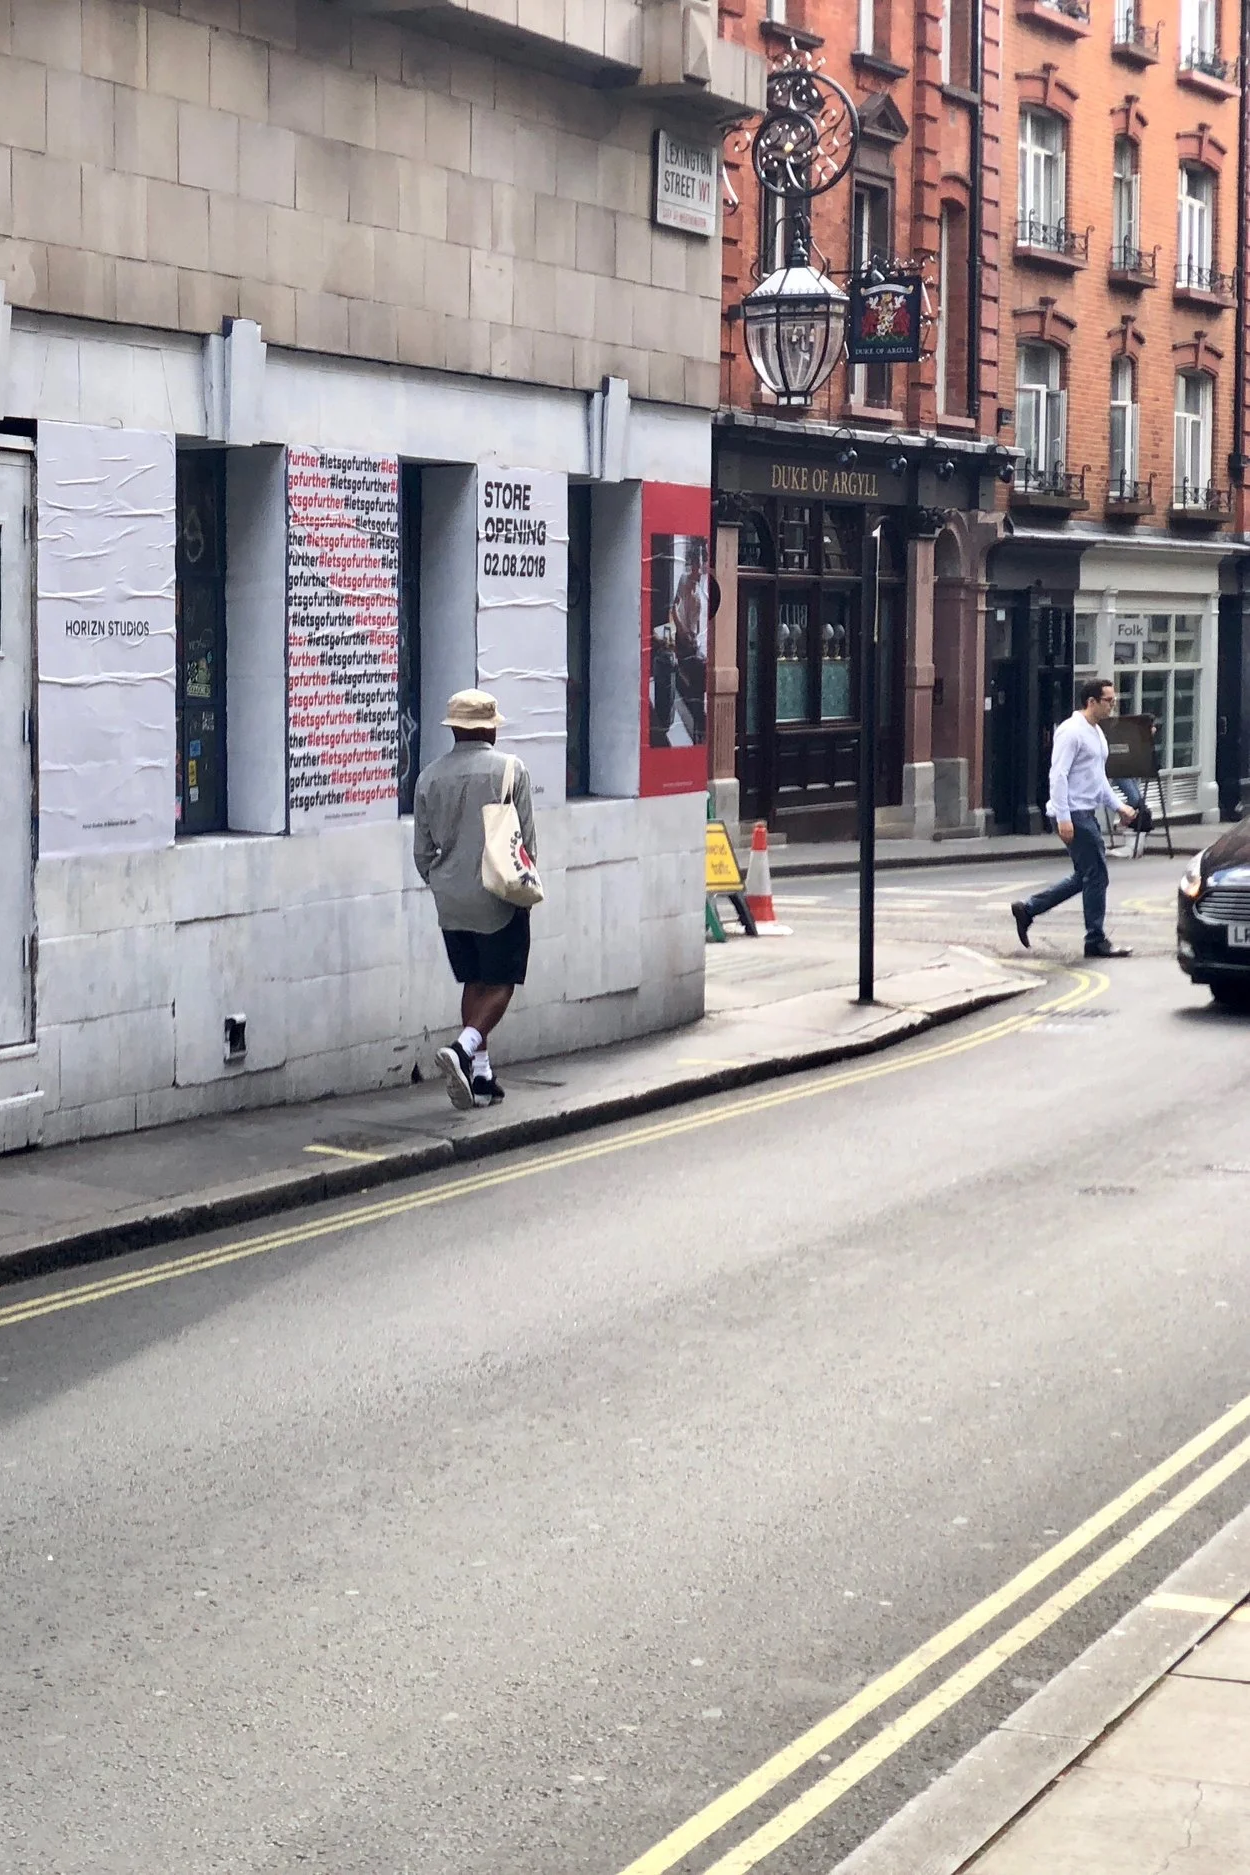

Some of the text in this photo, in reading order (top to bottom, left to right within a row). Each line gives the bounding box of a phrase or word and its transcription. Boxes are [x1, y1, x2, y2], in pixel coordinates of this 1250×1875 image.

[665, 140, 712, 176] LEXINGTON
[664, 170, 711, 204] STREET W1
[887, 346, 913, 354] ARGYLL
[771, 464, 878, 496] DUKE OF ARGYLL
[484, 481, 531, 511] STORE
[485, 516, 546, 546] OPENING
[484, 552, 546, 577] 02.08.2018
[65, 620, 150, 637] HORIZN STUDIOS
[1117, 623, 1143, 637] Folk
